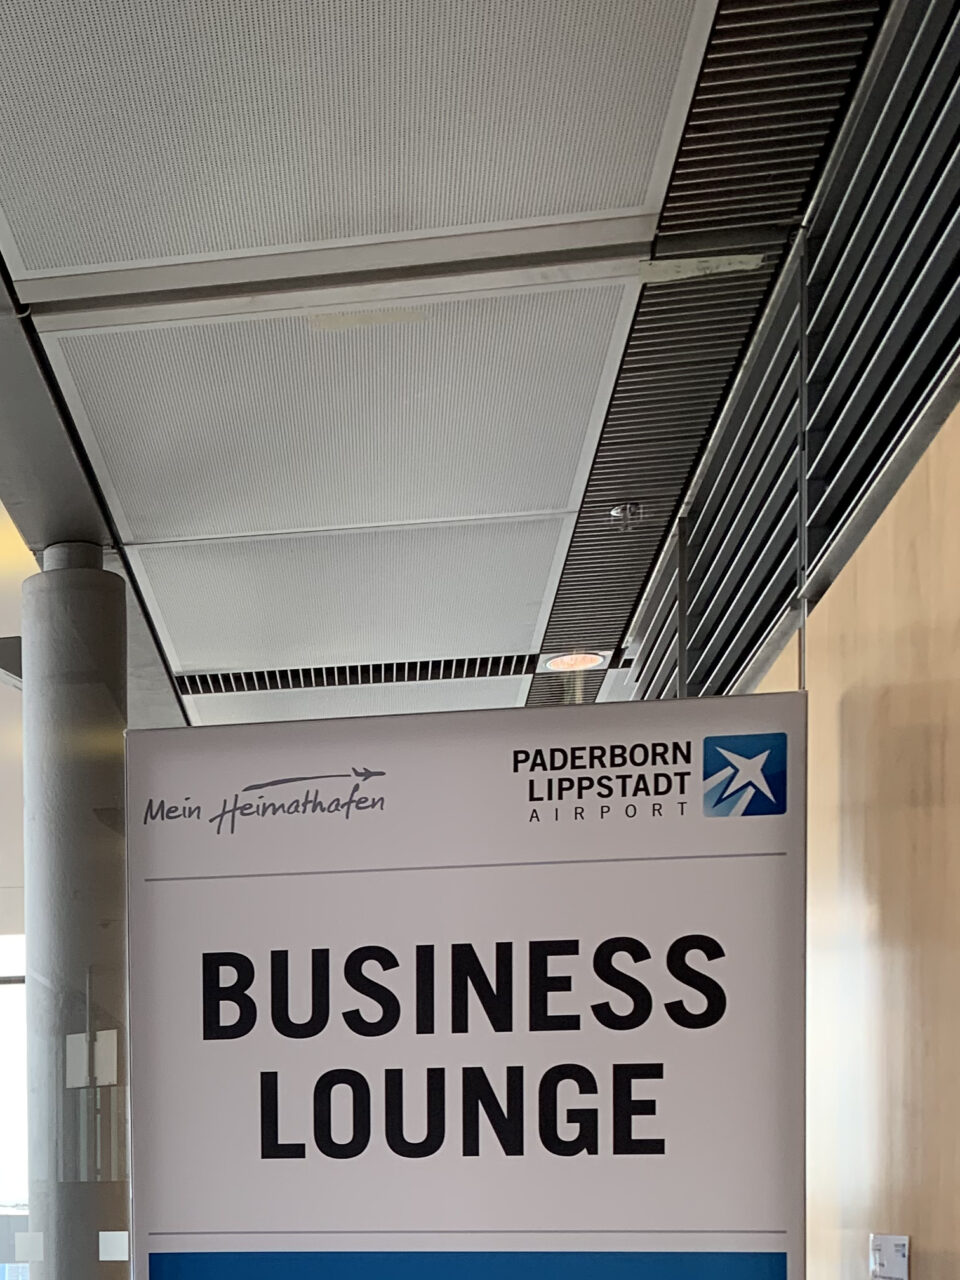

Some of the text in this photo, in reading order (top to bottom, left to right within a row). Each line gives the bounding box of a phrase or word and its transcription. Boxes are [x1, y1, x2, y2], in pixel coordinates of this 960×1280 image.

[513, 741, 692, 773] PADERBORN
[528, 772, 692, 802] LIPPSTADT
[143, 783, 385, 835] Mein Heimathafen
[529, 802, 688, 822] AIRPORT
[202, 934, 727, 1041] BUSINESS
[260, 1062, 666, 1160] LOUNGE
